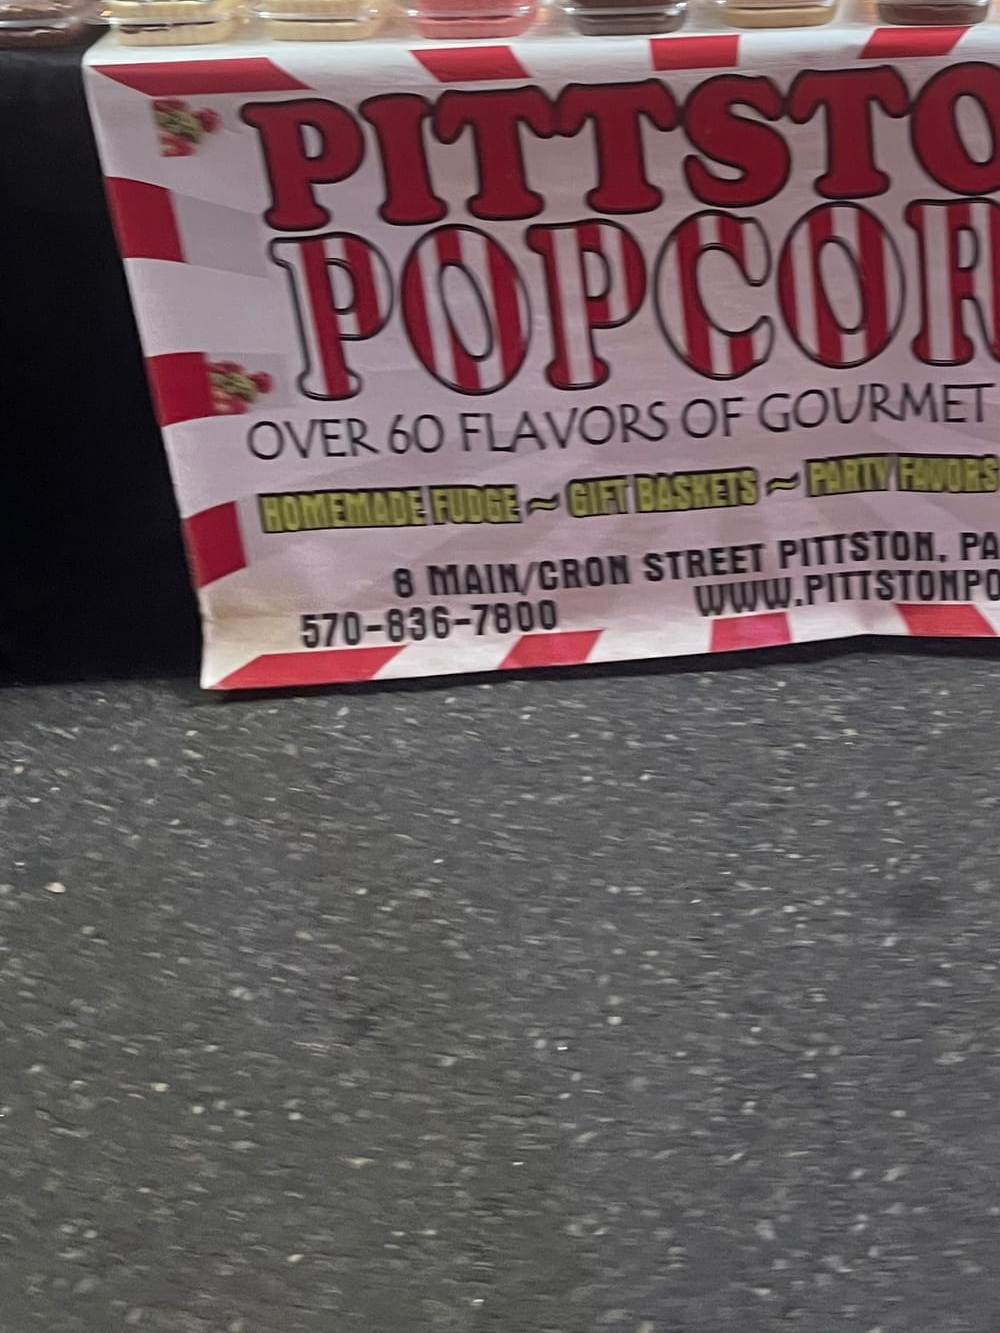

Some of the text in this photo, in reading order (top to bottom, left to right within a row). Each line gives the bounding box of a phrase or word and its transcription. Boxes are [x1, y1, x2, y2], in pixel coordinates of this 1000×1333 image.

[247, 417, 380, 460] OVER
[387, 413, 445, 454] 60
[460, 400, 670, 452] FLAVORS
[681, 396, 747, 439] OF
[757, 382, 996, 433] GOURMET
[257, 486, 427, 533] HOMEMADE
[428, 484, 523, 525] FUDGE
[567, 474, 629, 518] GIFT
[633, 466, 760, 513] BASKETS
[804, 452, 889, 497] PARTY
[896, 452, 1000, 493] FAVORS
[393, 567, 415, 598] 8
[642, 543, 765, 582] STREET
[778, 530, 947, 569] PITTSTON,
[960, 531, 1000, 560] PA
[300, 599, 558, 649] 570-836-7800
